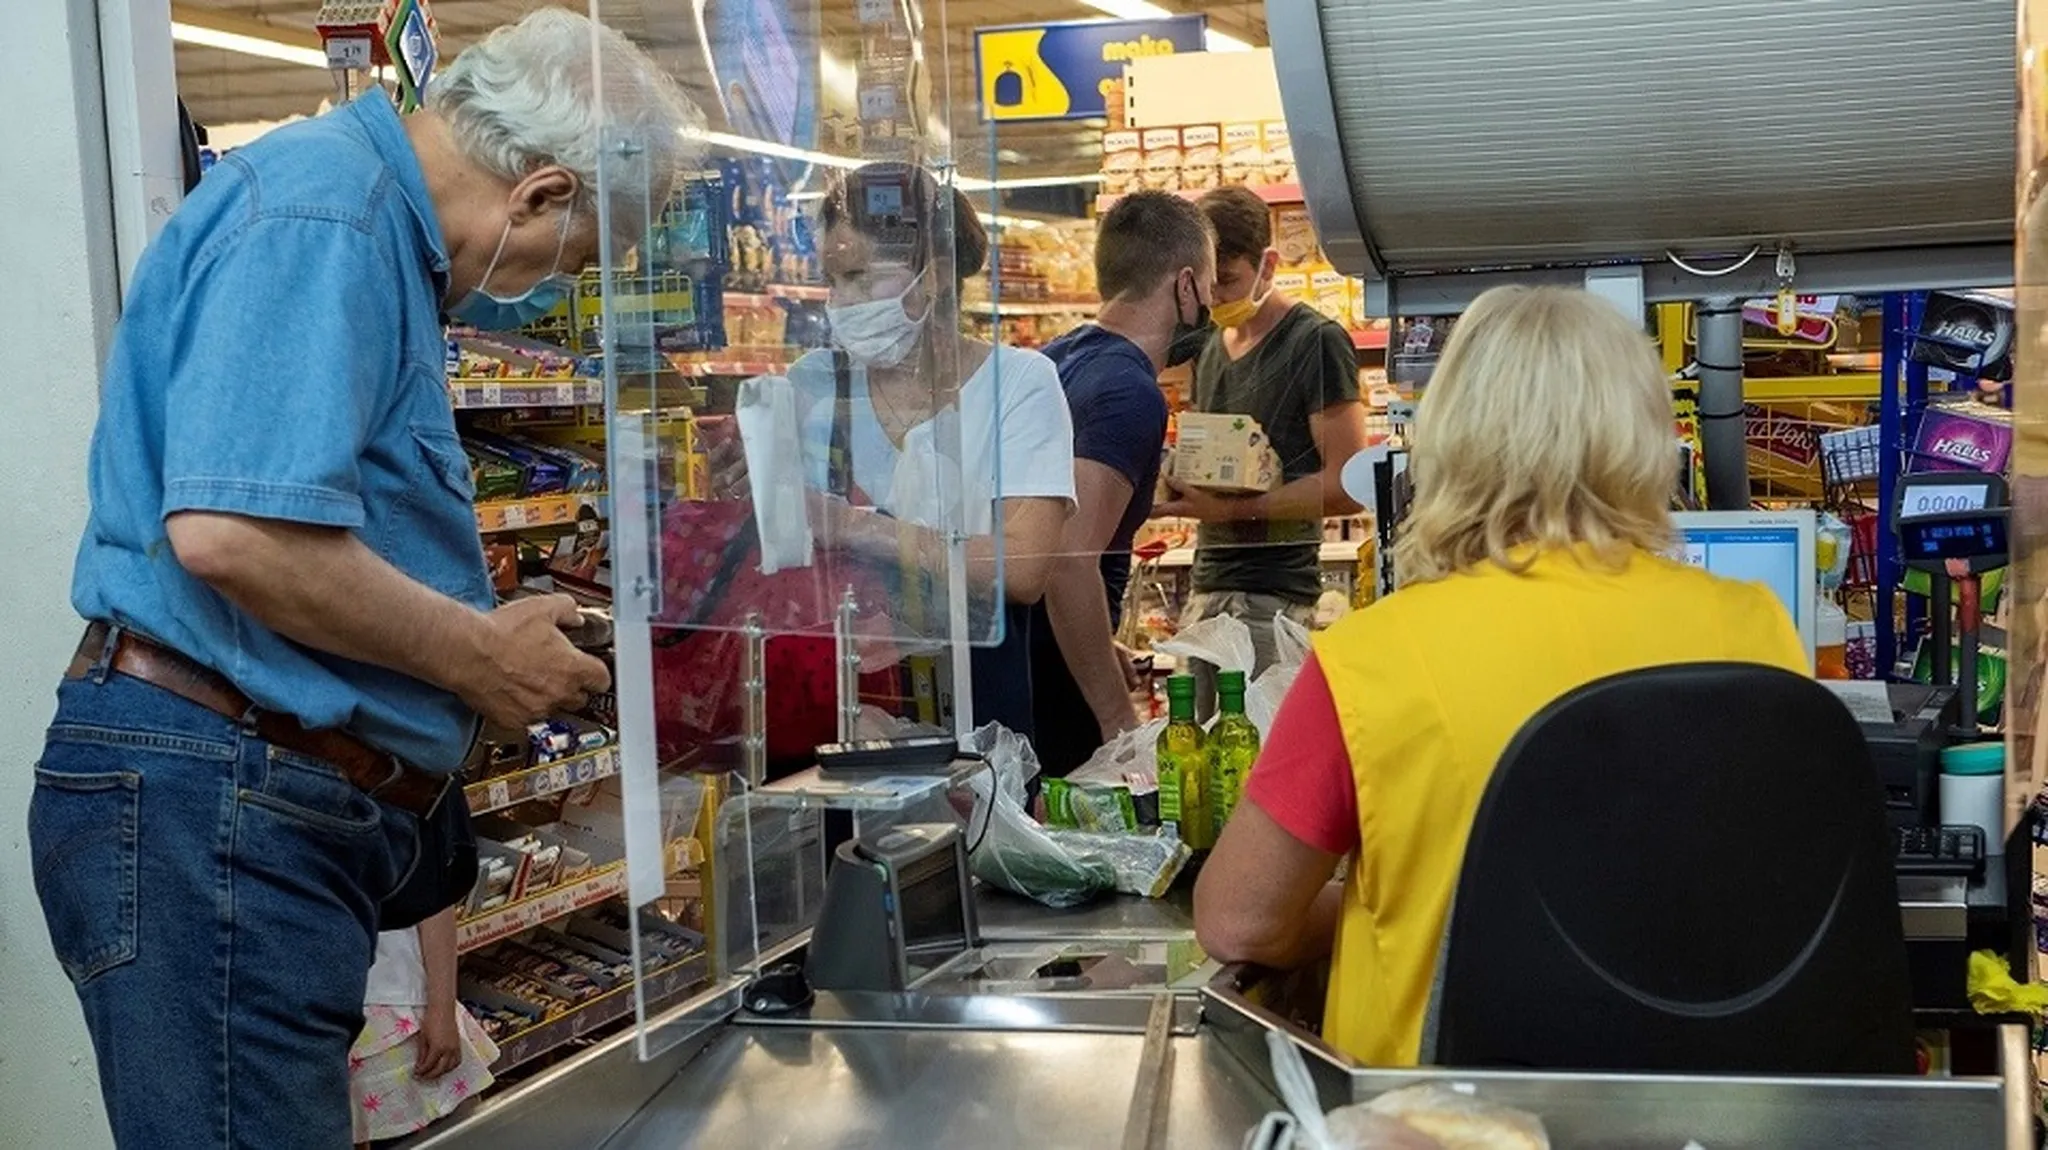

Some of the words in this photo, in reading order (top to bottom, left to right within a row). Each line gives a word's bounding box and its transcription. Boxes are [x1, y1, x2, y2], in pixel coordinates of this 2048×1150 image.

[1934, 321, 1996, 346] HALLS
[1932, 439, 1992, 462] HALLS
[1917, 495, 1969, 512] 0.000
